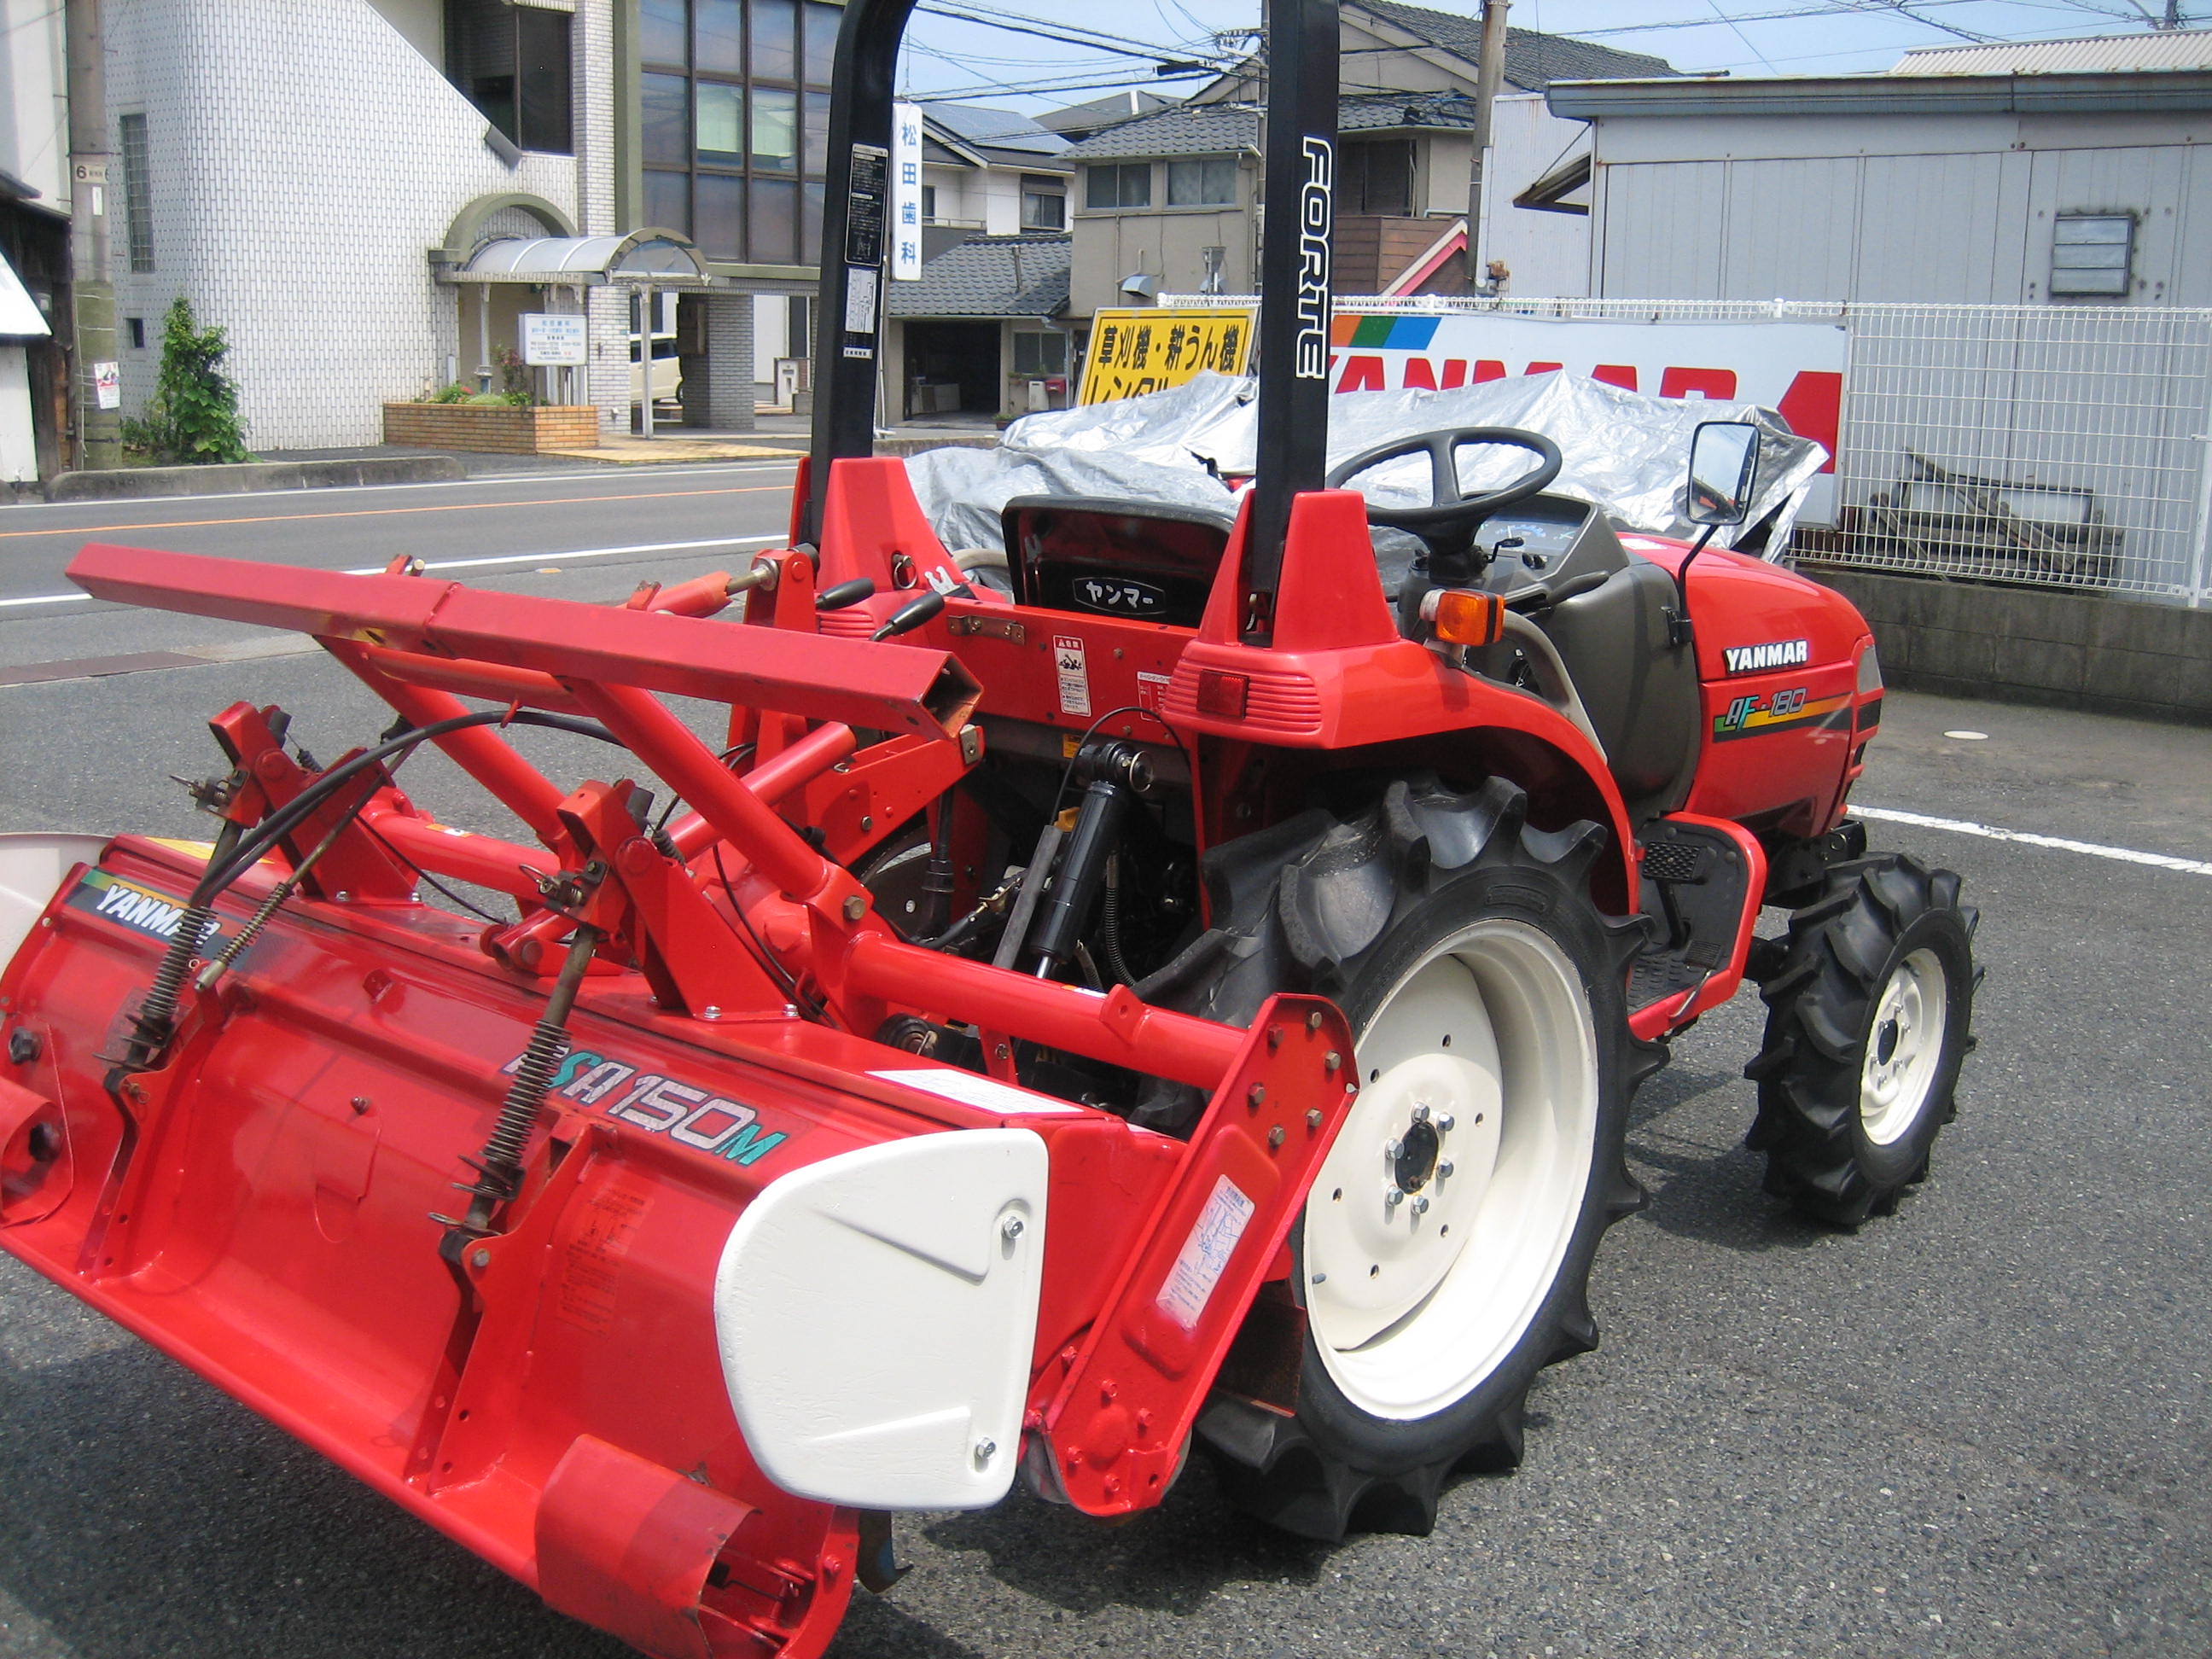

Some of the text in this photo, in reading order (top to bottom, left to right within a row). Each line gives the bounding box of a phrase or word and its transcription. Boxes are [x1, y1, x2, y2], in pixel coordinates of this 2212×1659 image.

[901, 123, 917, 265] 松田歯科
[1295, 137, 1332, 379] FORTE
[1098, 324, 1239, 371] 草刈機・耕うん機
[1086, 581, 1154, 608] ヤンマー
[1725, 640, 1807, 672] YANMAR
[96, 884, 222, 946] YANMR
[500, 1045, 788, 1167] SA150M
